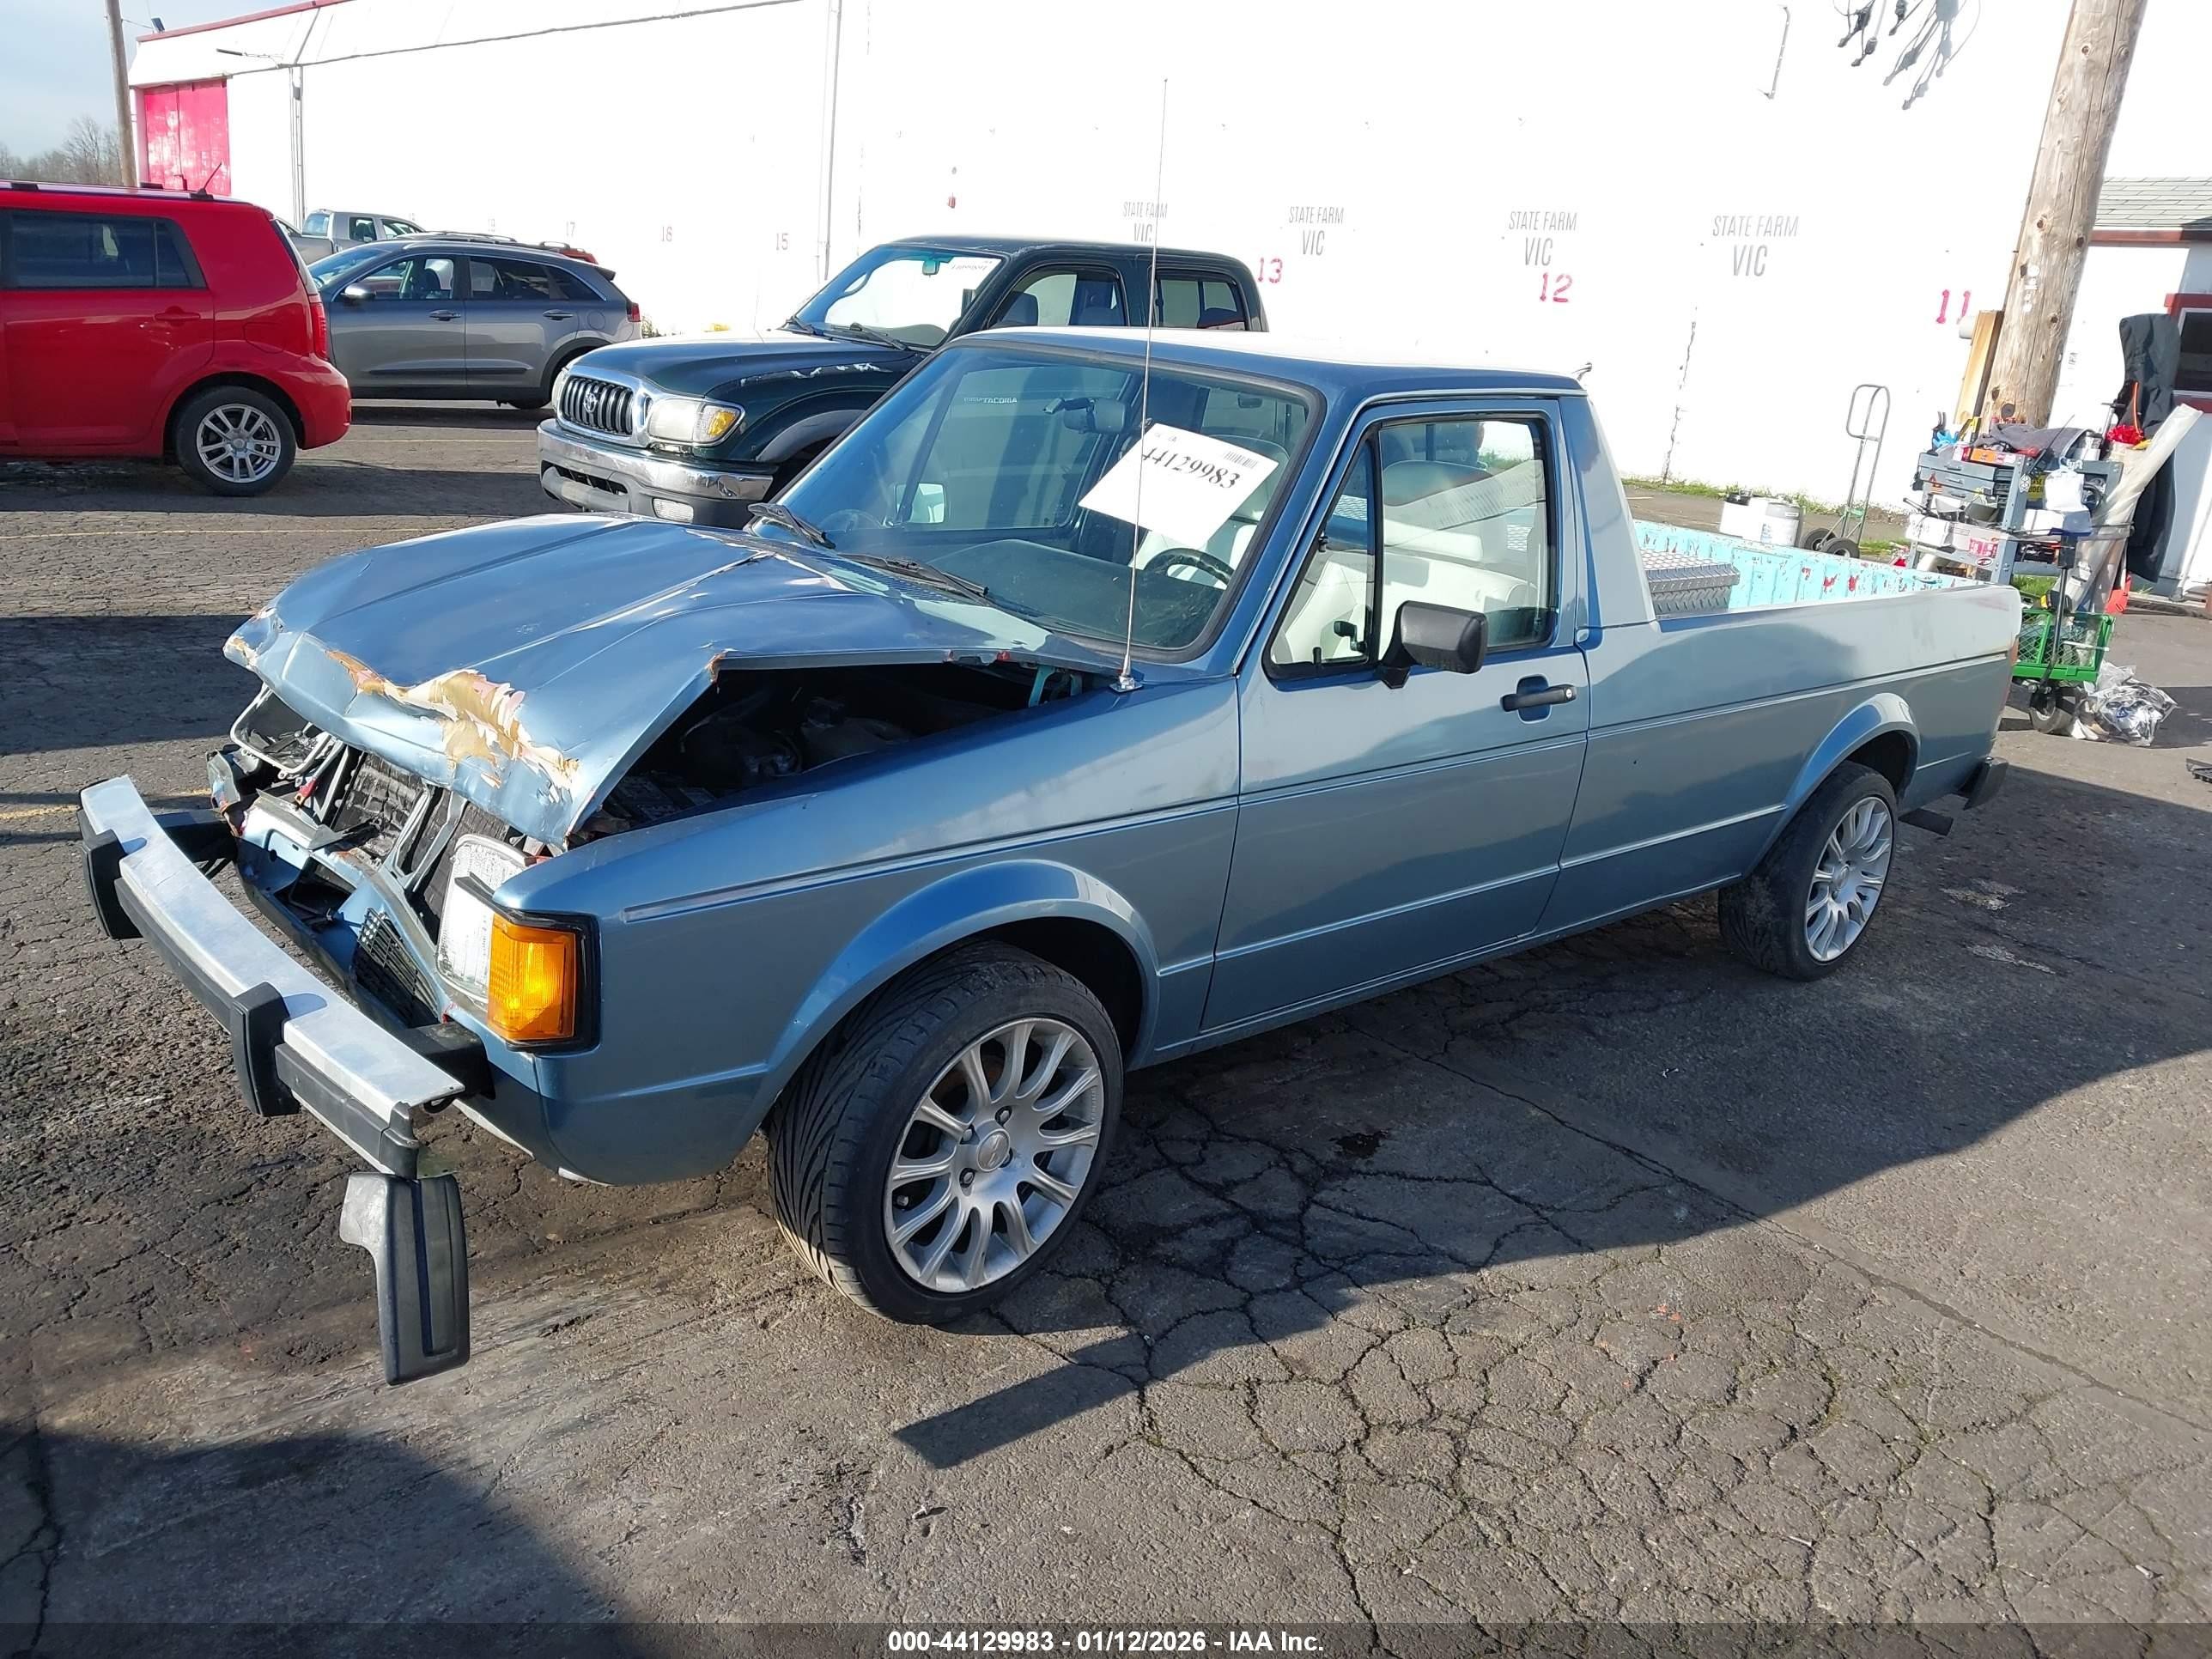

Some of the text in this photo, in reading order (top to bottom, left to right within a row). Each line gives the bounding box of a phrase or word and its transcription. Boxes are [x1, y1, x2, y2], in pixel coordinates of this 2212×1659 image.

[1123, 202, 1168, 220] STATE FARM
[1288, 206, 1345, 224] STATE FARM
[1508, 210, 1577, 231] STATE FARM
[565, 221, 576, 236] 17
[1133, 223, 1152, 242] VIC
[1712, 215, 1799, 237] STATE FARM
[776, 232, 789, 252] 15
[1302, 230, 1325, 256] VIC
[1524, 237, 1554, 266] VIC
[1257, 258, 1283, 284] 13
[1733, 245, 1768, 276] VIC
[1539, 272, 1573, 303] 12
[1936, 289, 1972, 325] 11
[1143, 447, 1240, 488] 44129983
